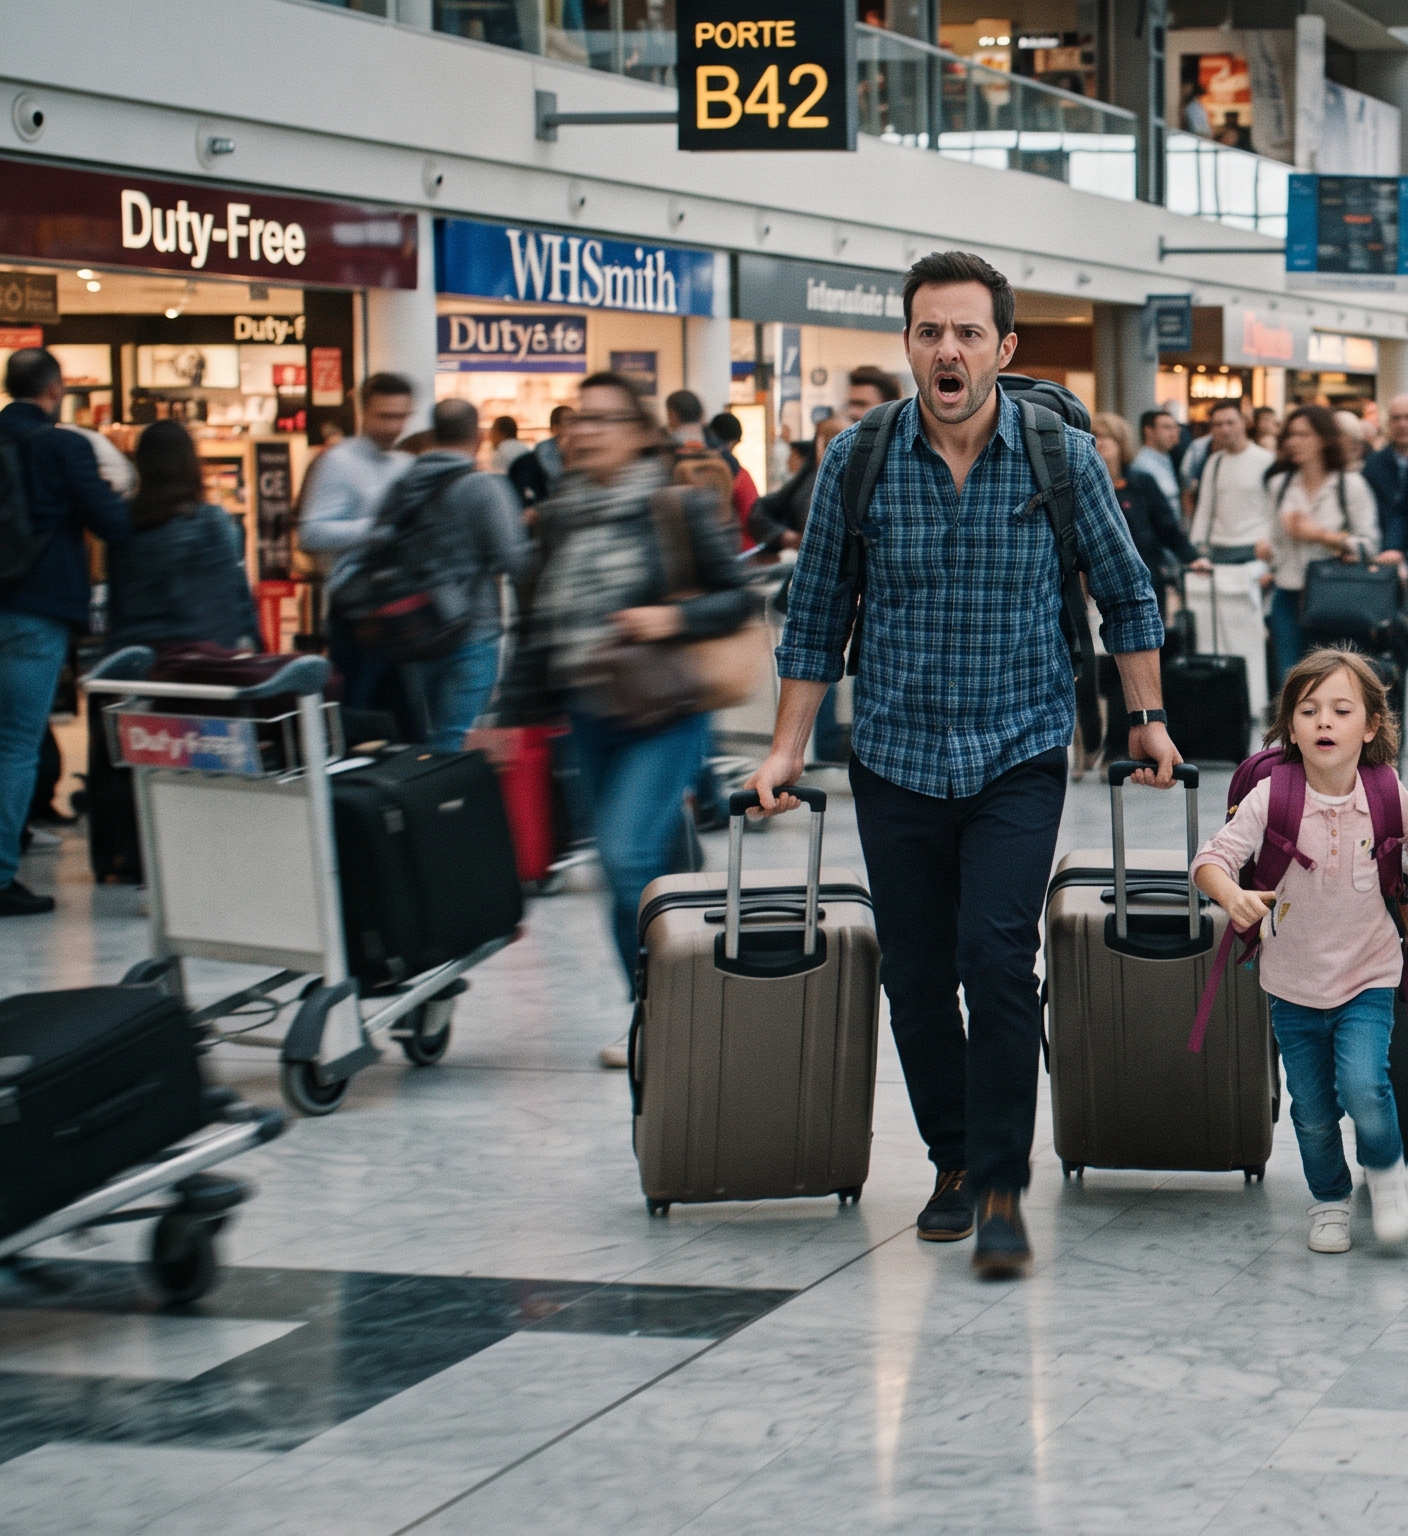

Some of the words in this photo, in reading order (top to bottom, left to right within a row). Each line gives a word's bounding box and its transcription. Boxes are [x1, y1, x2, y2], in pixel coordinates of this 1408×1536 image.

[695, 20, 796, 49] PORTE
[696, 62, 829, 130] B42
[121, 189, 307, 269] Duty-Free
[505, 228, 677, 313] WHSmith
